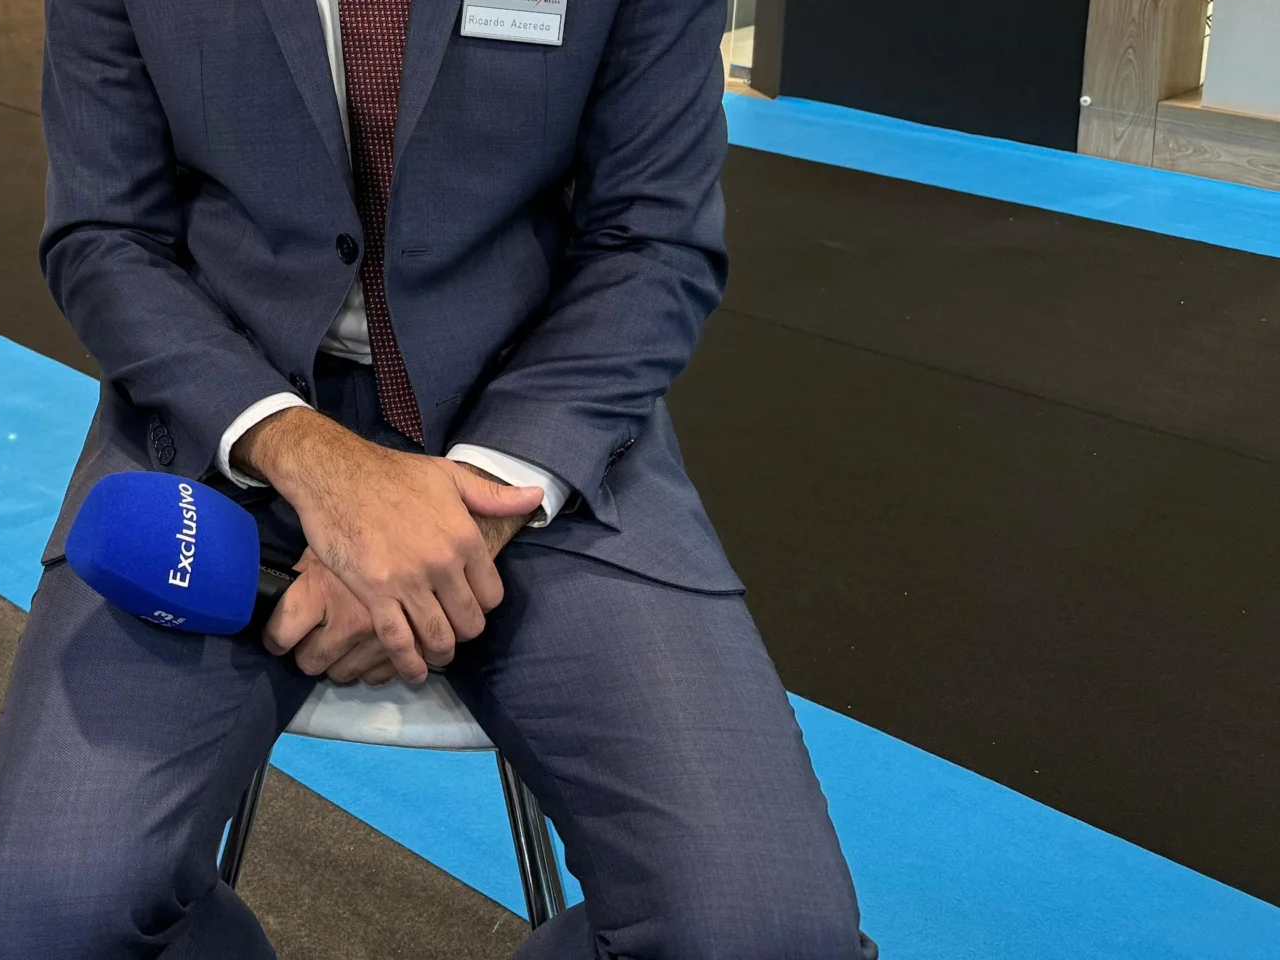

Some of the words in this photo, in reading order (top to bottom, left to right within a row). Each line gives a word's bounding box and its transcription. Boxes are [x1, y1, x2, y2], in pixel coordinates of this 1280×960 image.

[468, 14, 505, 28] Ricardo
[510, 19, 551, 32] Azeredo
[168, 482, 197, 588] Exclusivo
